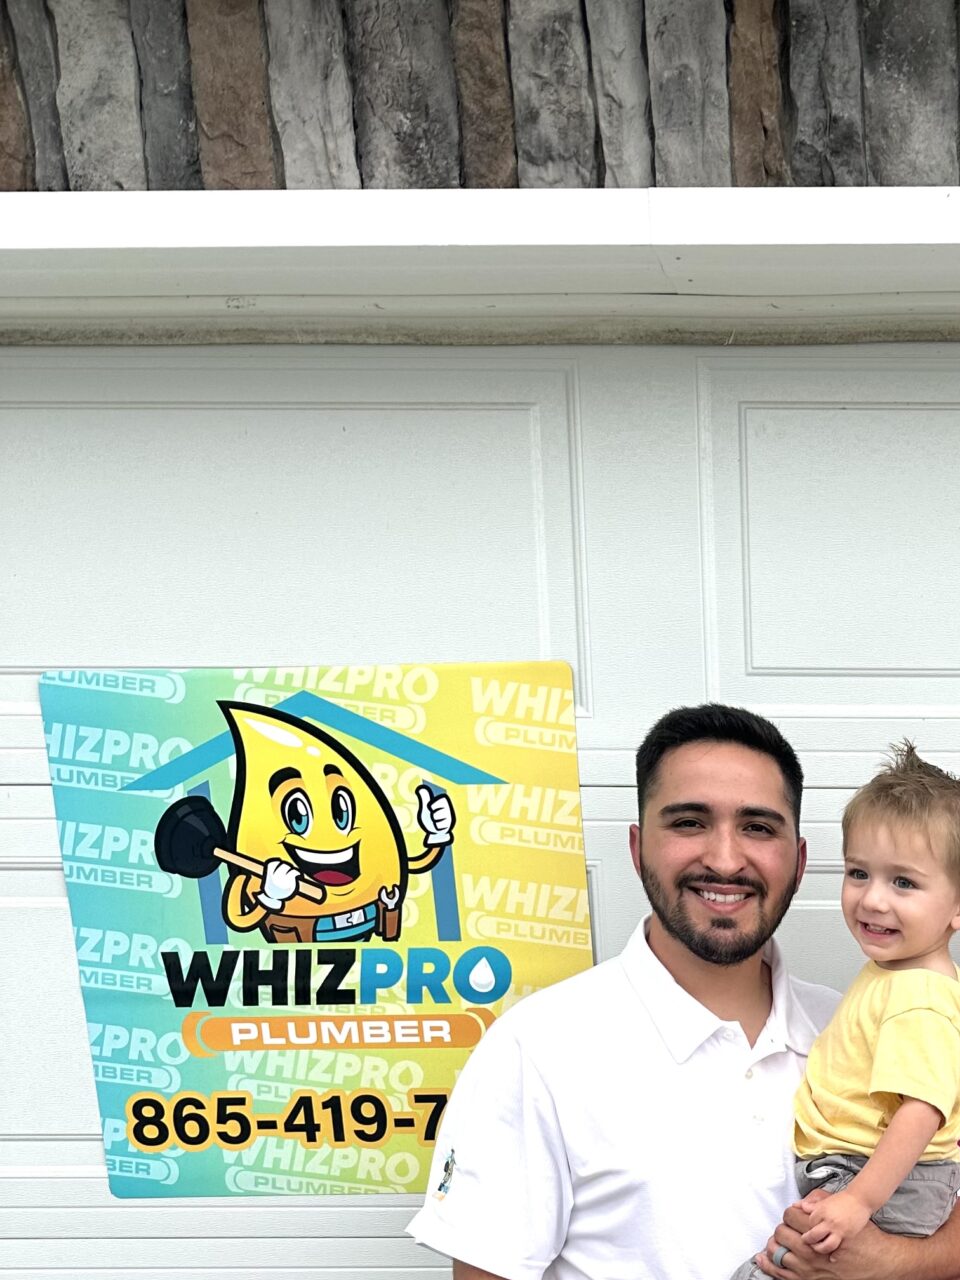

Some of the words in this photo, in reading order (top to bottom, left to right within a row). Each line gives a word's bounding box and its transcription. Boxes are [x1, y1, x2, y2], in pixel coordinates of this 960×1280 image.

[44, 722, 195, 770] HIZPRO
[466, 784, 582, 827] WHIZ
[56, 820, 155, 865] IZPR
[501, 828, 584, 850] PLUM
[160, 945, 512, 1007] WHIZPRO
[230, 1019, 451, 1046] PLUMBER
[223, 1051, 424, 1093] WHIZPRO
[222, 1137, 419, 1184] WHIZPRO
